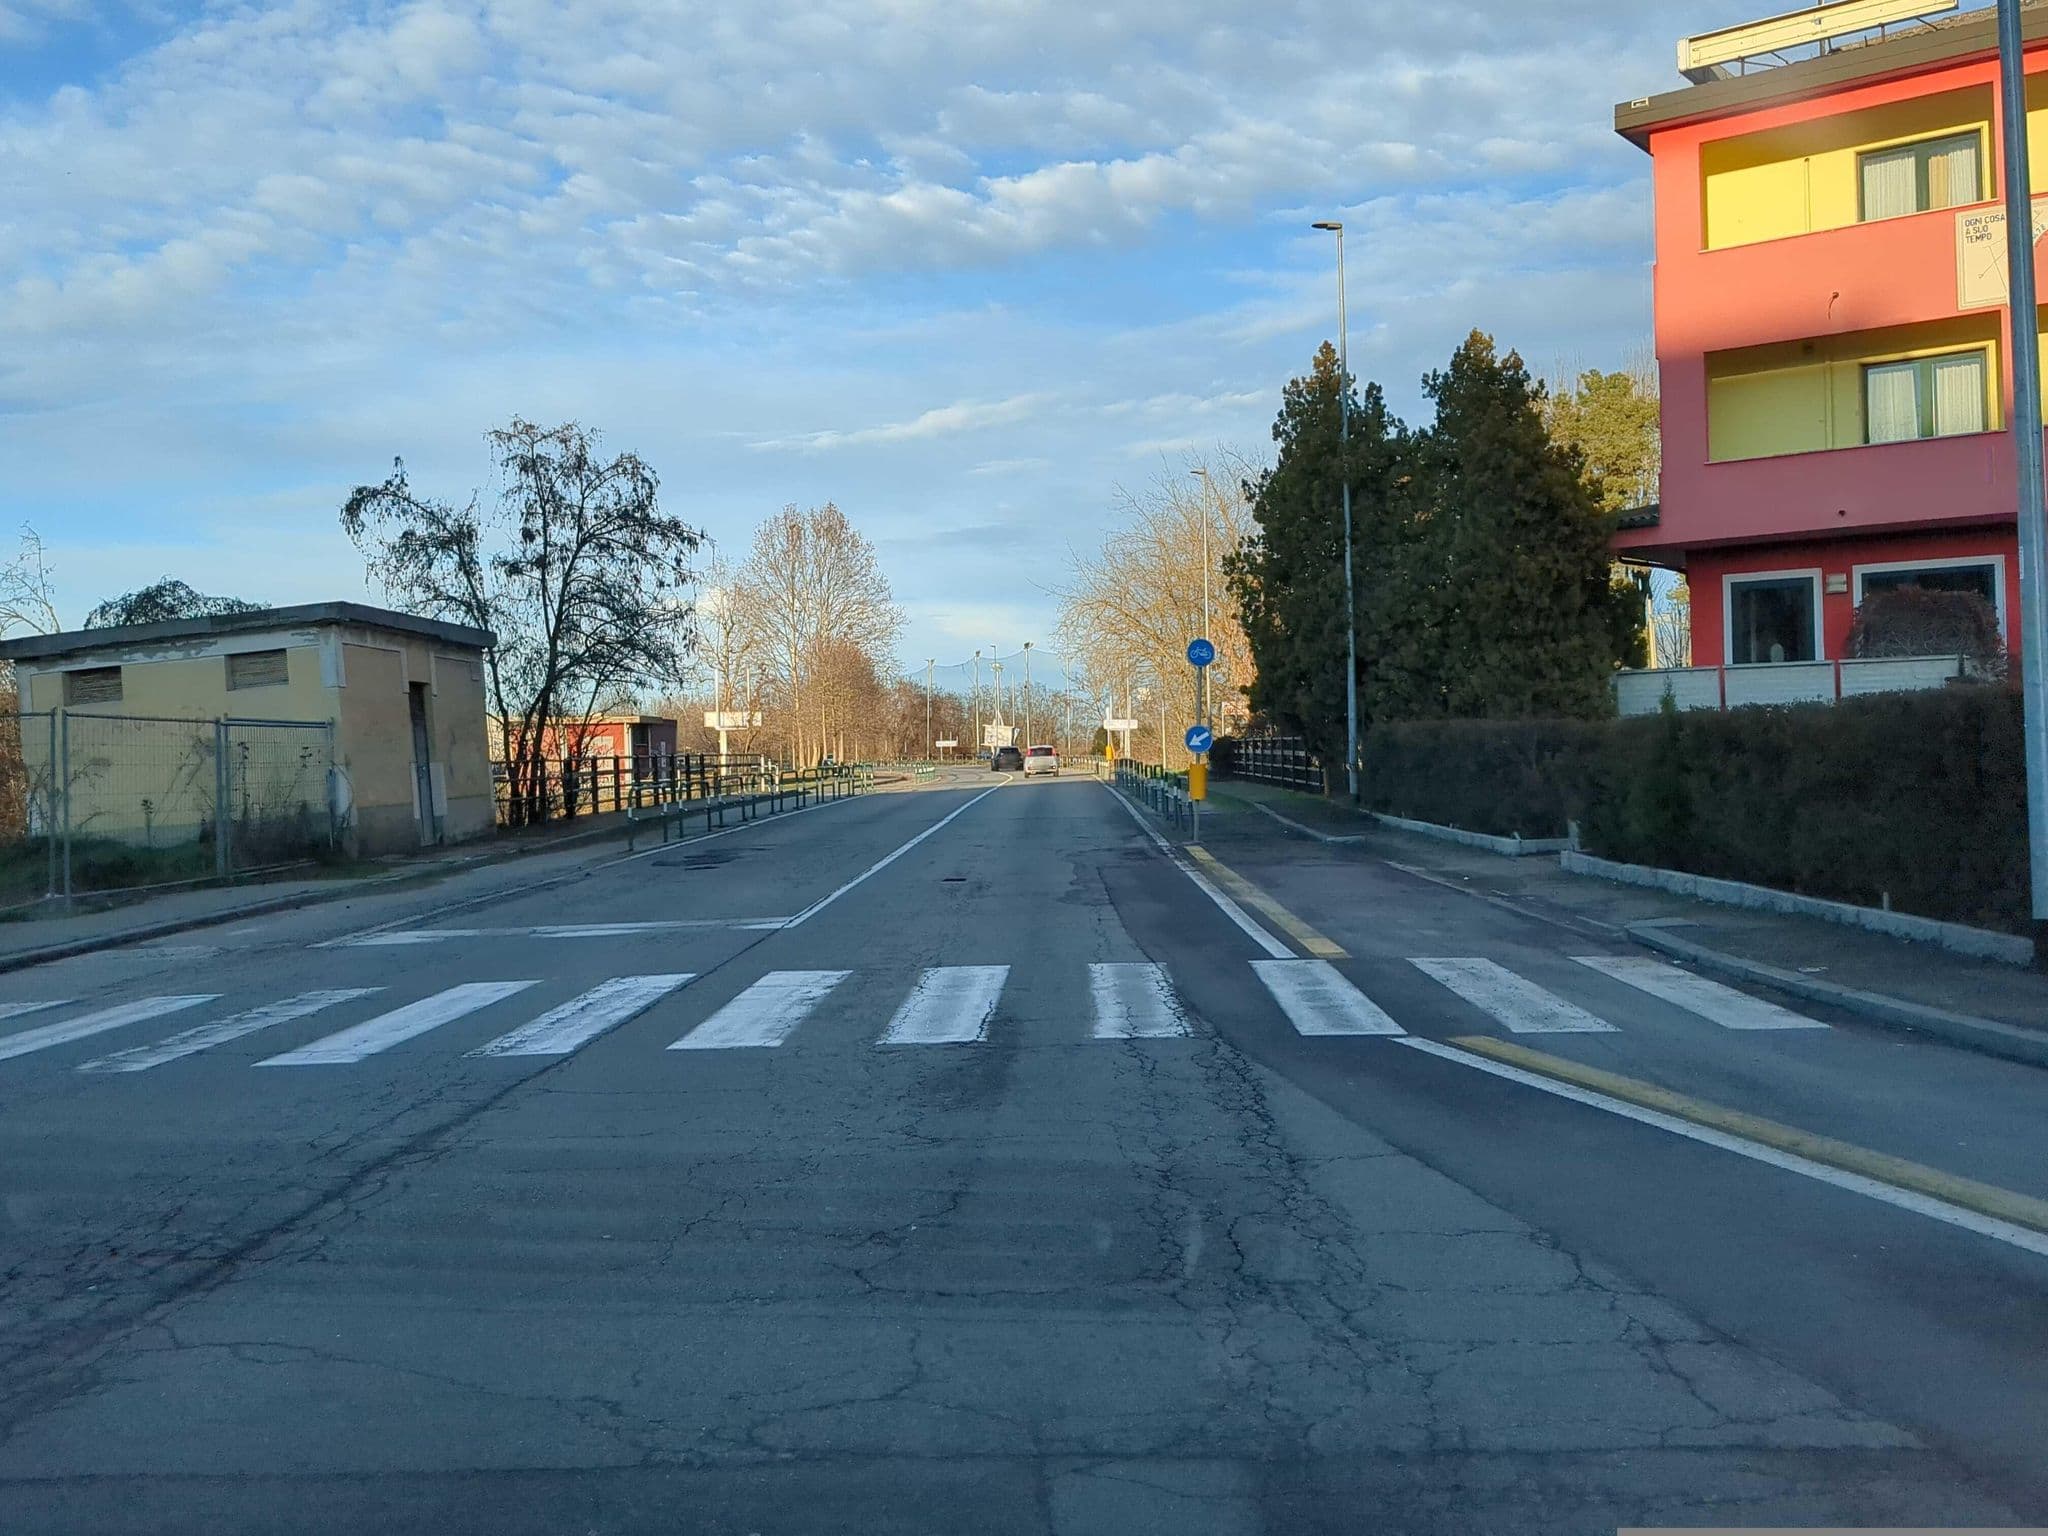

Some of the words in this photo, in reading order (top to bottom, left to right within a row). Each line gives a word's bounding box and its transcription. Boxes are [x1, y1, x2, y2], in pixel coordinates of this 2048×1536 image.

[1965, 217, 1982, 227] OGNI
[1984, 213, 2005, 224] COSA
[1965, 233, 1992, 243] TEMPO
